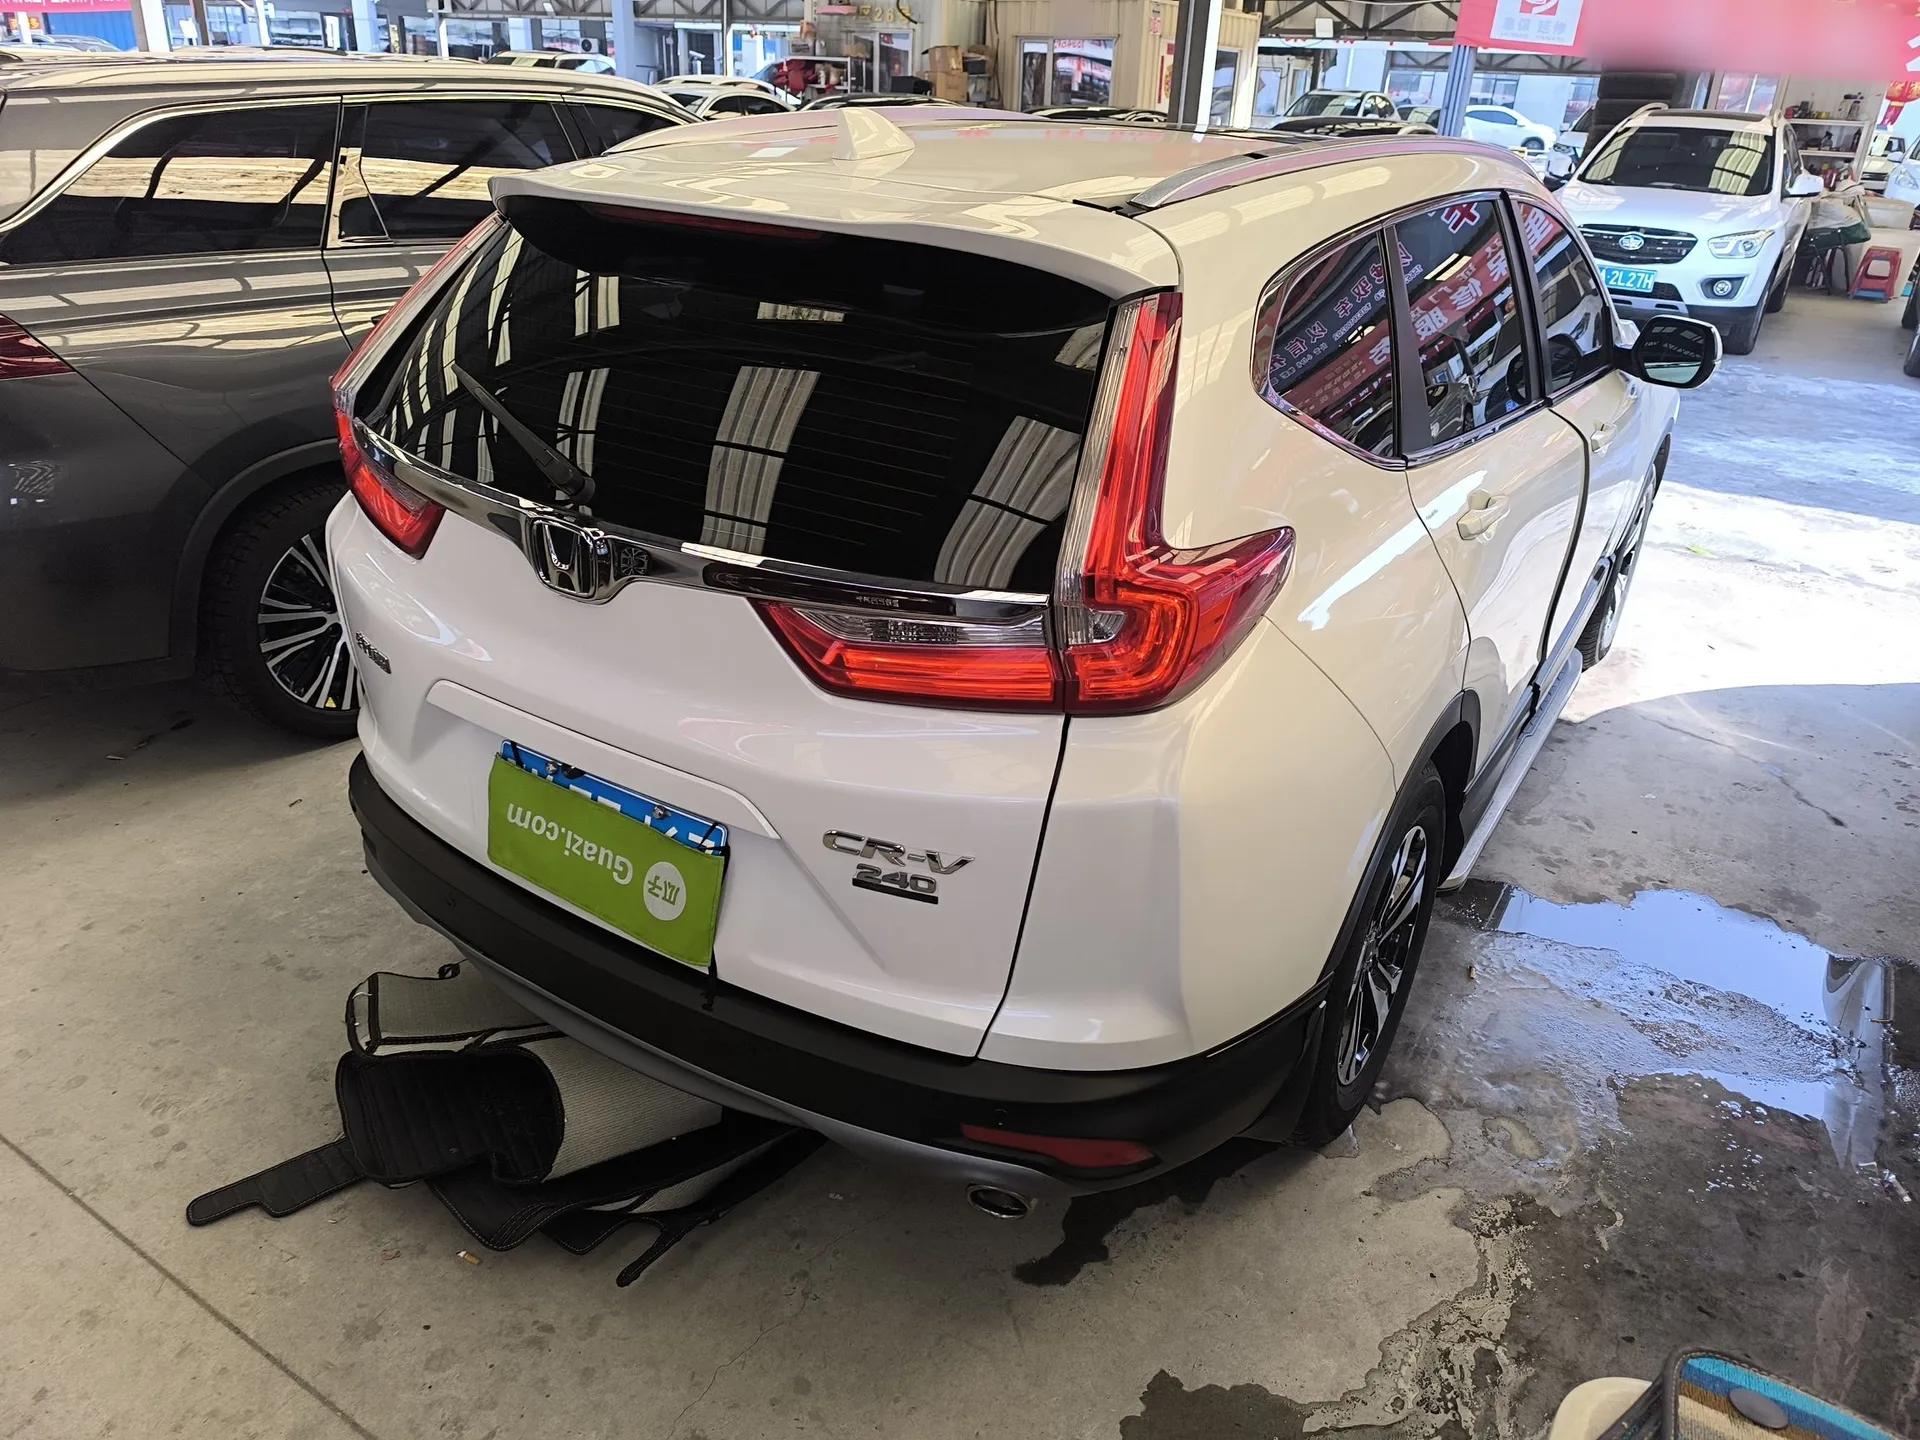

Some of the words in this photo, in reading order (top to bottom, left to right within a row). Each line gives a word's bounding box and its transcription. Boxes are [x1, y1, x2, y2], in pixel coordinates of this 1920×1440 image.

[507, 803, 634, 885] Guazi.com
[823, 829, 976, 875] CR-V
[647, 875, 680, 907] 瓜子
[856, 863, 938, 894] 240
